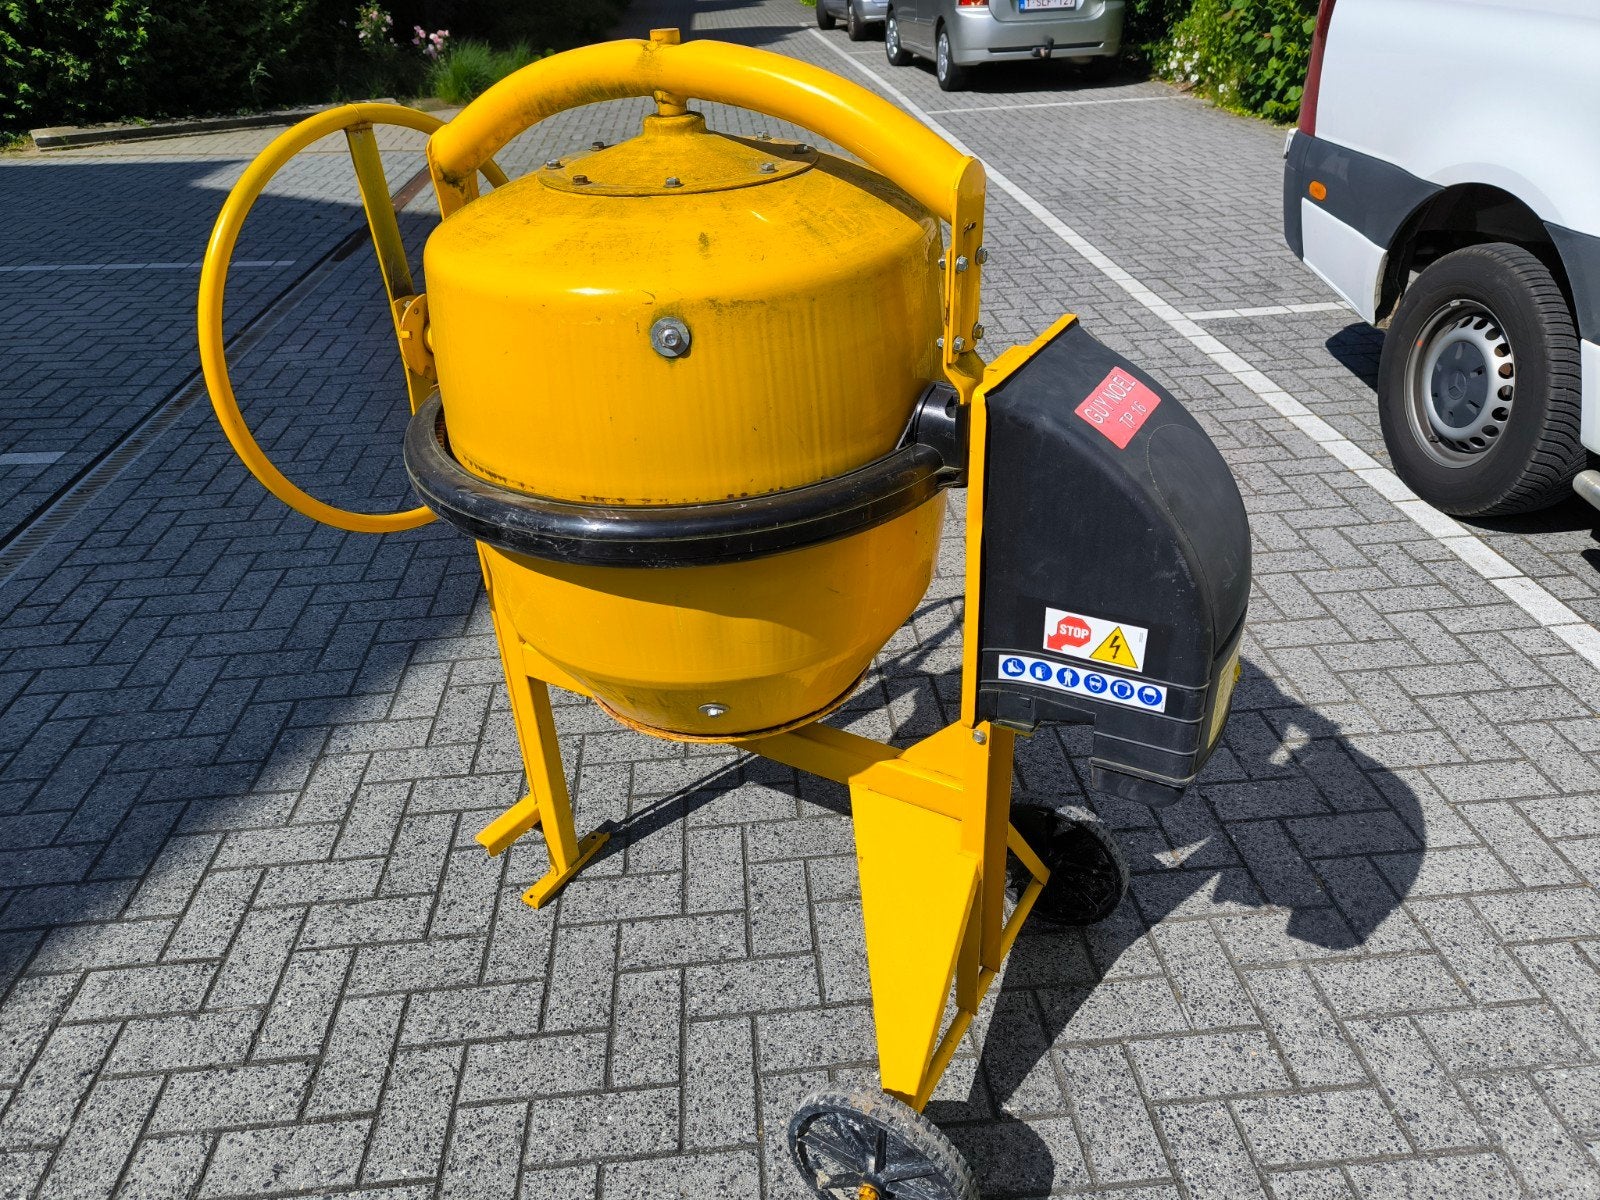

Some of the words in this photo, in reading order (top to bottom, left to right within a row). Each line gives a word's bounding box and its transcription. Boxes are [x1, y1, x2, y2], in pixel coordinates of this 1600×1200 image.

[1084, 395, 1114, 424] GUY
[1101, 374, 1136, 405] NOEL
[1119, 412, 1136, 429] TP
[1130, 400, 1147, 416] 16
[1059, 623, 1090, 640] STOP
